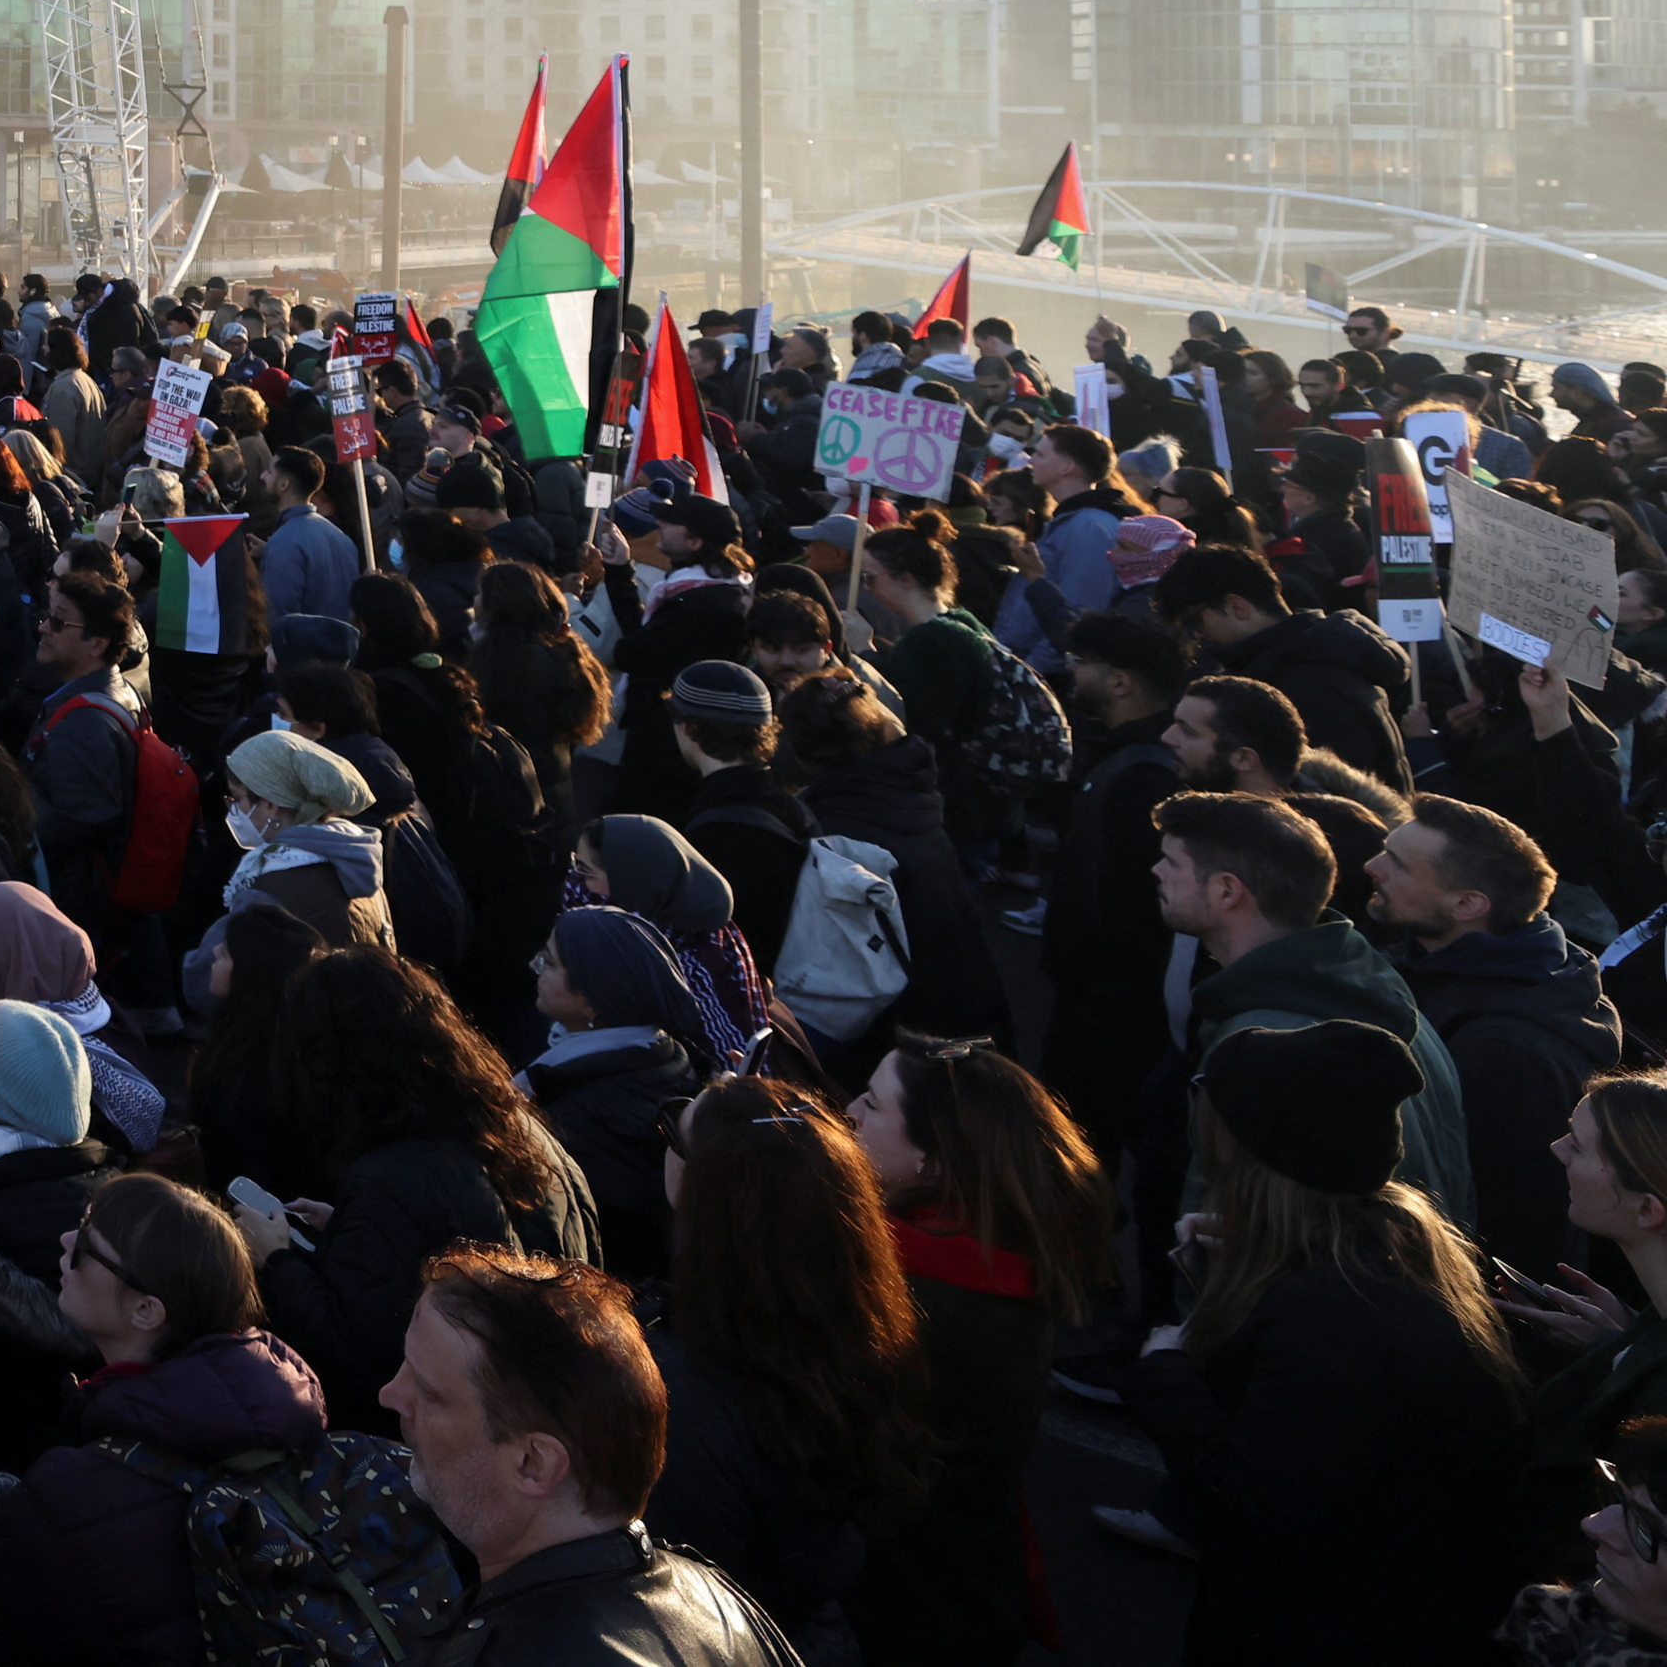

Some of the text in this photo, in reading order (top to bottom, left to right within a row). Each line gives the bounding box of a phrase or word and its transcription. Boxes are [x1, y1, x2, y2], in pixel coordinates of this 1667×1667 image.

[357, 303, 394, 316] FREEDOM
[355, 320, 395, 334] PALESTINE
[158, 378, 201, 402] STOP THE WAR
[159, 391, 191, 410] ON GAZA!
[173, 406, 190, 420] MASS
[827, 388, 963, 441] CEASEFIRE
[1430, 504, 1450, 521] top
[1381, 535, 1433, 564] PALESTINE
[1561, 528, 1603, 553] SAID
